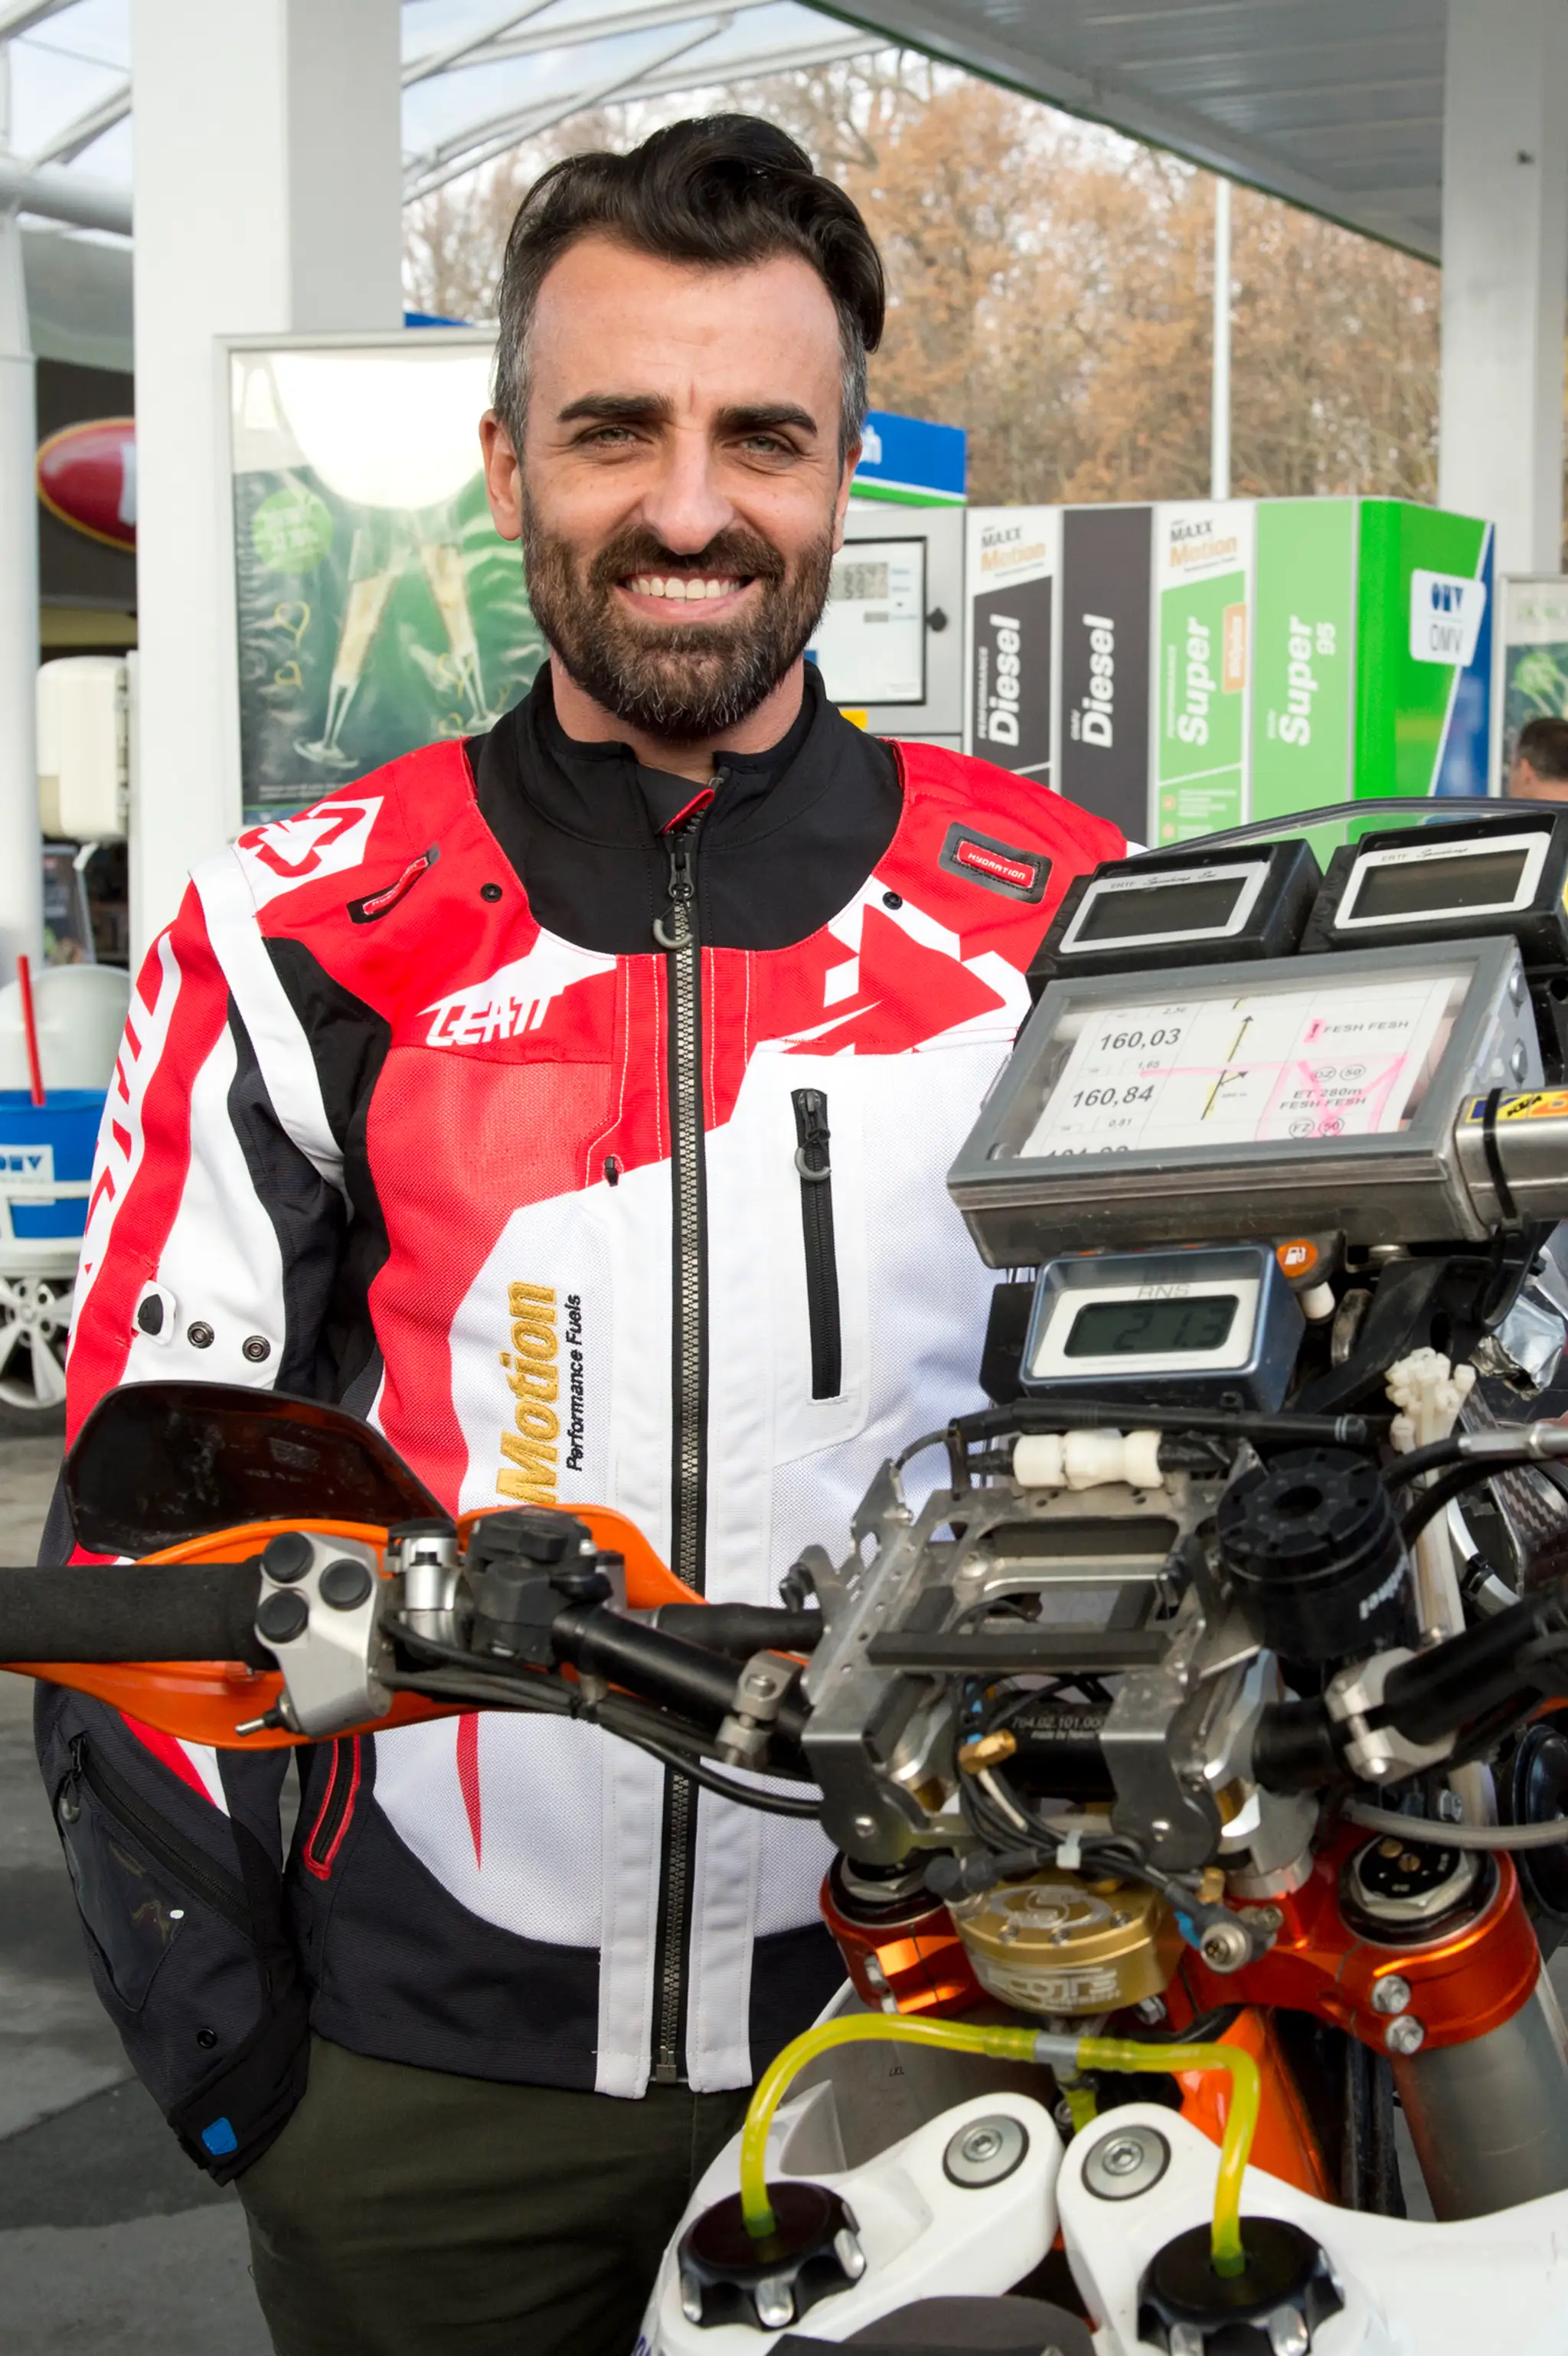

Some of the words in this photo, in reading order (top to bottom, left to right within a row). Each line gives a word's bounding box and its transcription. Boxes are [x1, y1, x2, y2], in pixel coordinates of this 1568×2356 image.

[1431, 582, 1463, 612] OMV
[1315, 621, 1336, 656] 95
[1429, 623, 1462, 653] OMV
[988, 613, 1021, 747] Diesel
[1082, 613, 1114, 748] Diesel
[1177, 615, 1217, 746] Super
[1278, 614, 1318, 747] Super
[967, 853, 1026, 880] HYDRATION
[426, 995, 552, 1047] LEATT
[1323, 1024, 1364, 1033] FESH
[1368, 1020, 1409, 1031] FESH
[1100, 1028, 1181, 1051] 160,03
[1073, 1084, 1155, 1108] 160,84
[1279, 1100, 1320, 1109] FESH
[1325, 1097, 1367, 1107] FESH
[1138, 1286, 1189, 1299] RNS
[564, 1294, 583, 1345] Fuels
[496, 1280, 560, 1505] Motion
[565, 1349, 583, 1472] Performance
